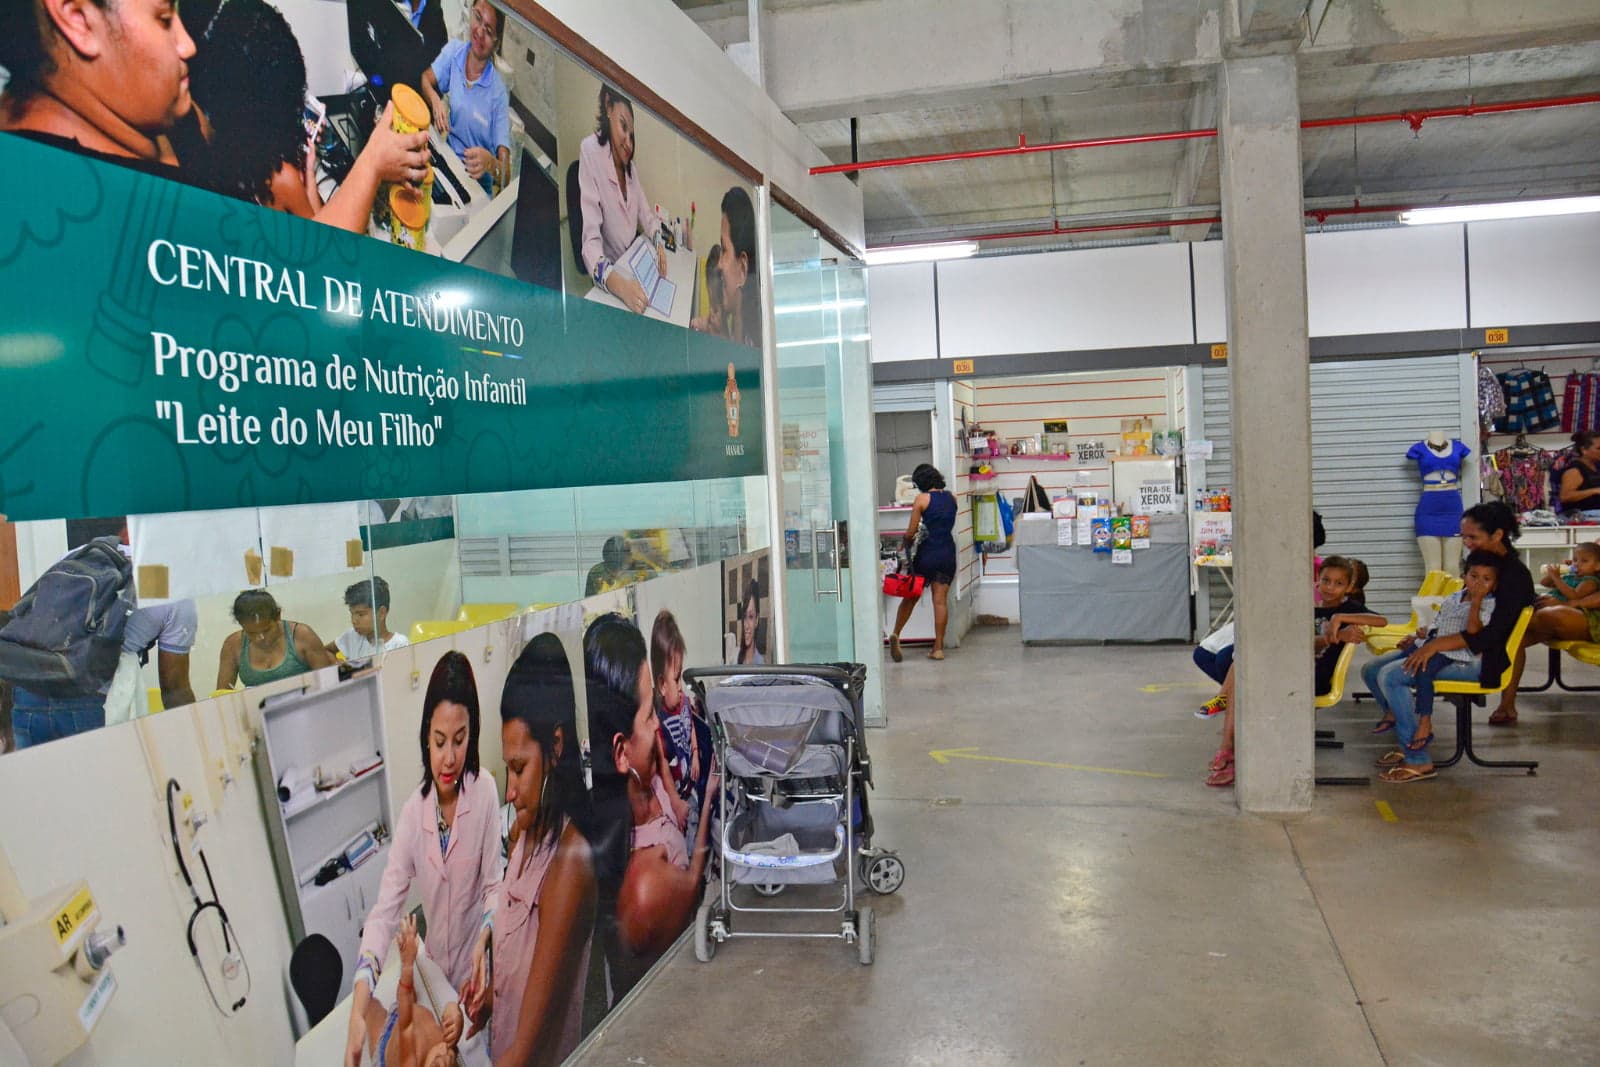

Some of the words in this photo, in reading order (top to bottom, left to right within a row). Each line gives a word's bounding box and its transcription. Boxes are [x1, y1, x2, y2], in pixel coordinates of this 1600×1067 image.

[147, 239, 318, 310] CENTRAL
[322, 275, 364, 318] DE
[370, 287, 524, 347] ATENDIMENTO
[1488, 333, 1504, 342] 038
[150, 331, 317, 393] Programa
[325, 354, 357, 391] de
[362, 358, 459, 405] Nutrição
[465, 371, 527, 405] Infantil
[155, 400, 261, 444] "Leite
[271, 407, 308, 446] do
[316, 408, 374, 448] Meu
[379, 411, 442, 447] Filho"
[1078, 449, 1105, 461] XEROX
[1139, 485, 1172, 495] TIRA-SE
[1140, 494, 1172, 506] XEROX
[56, 912, 73, 939] AR
